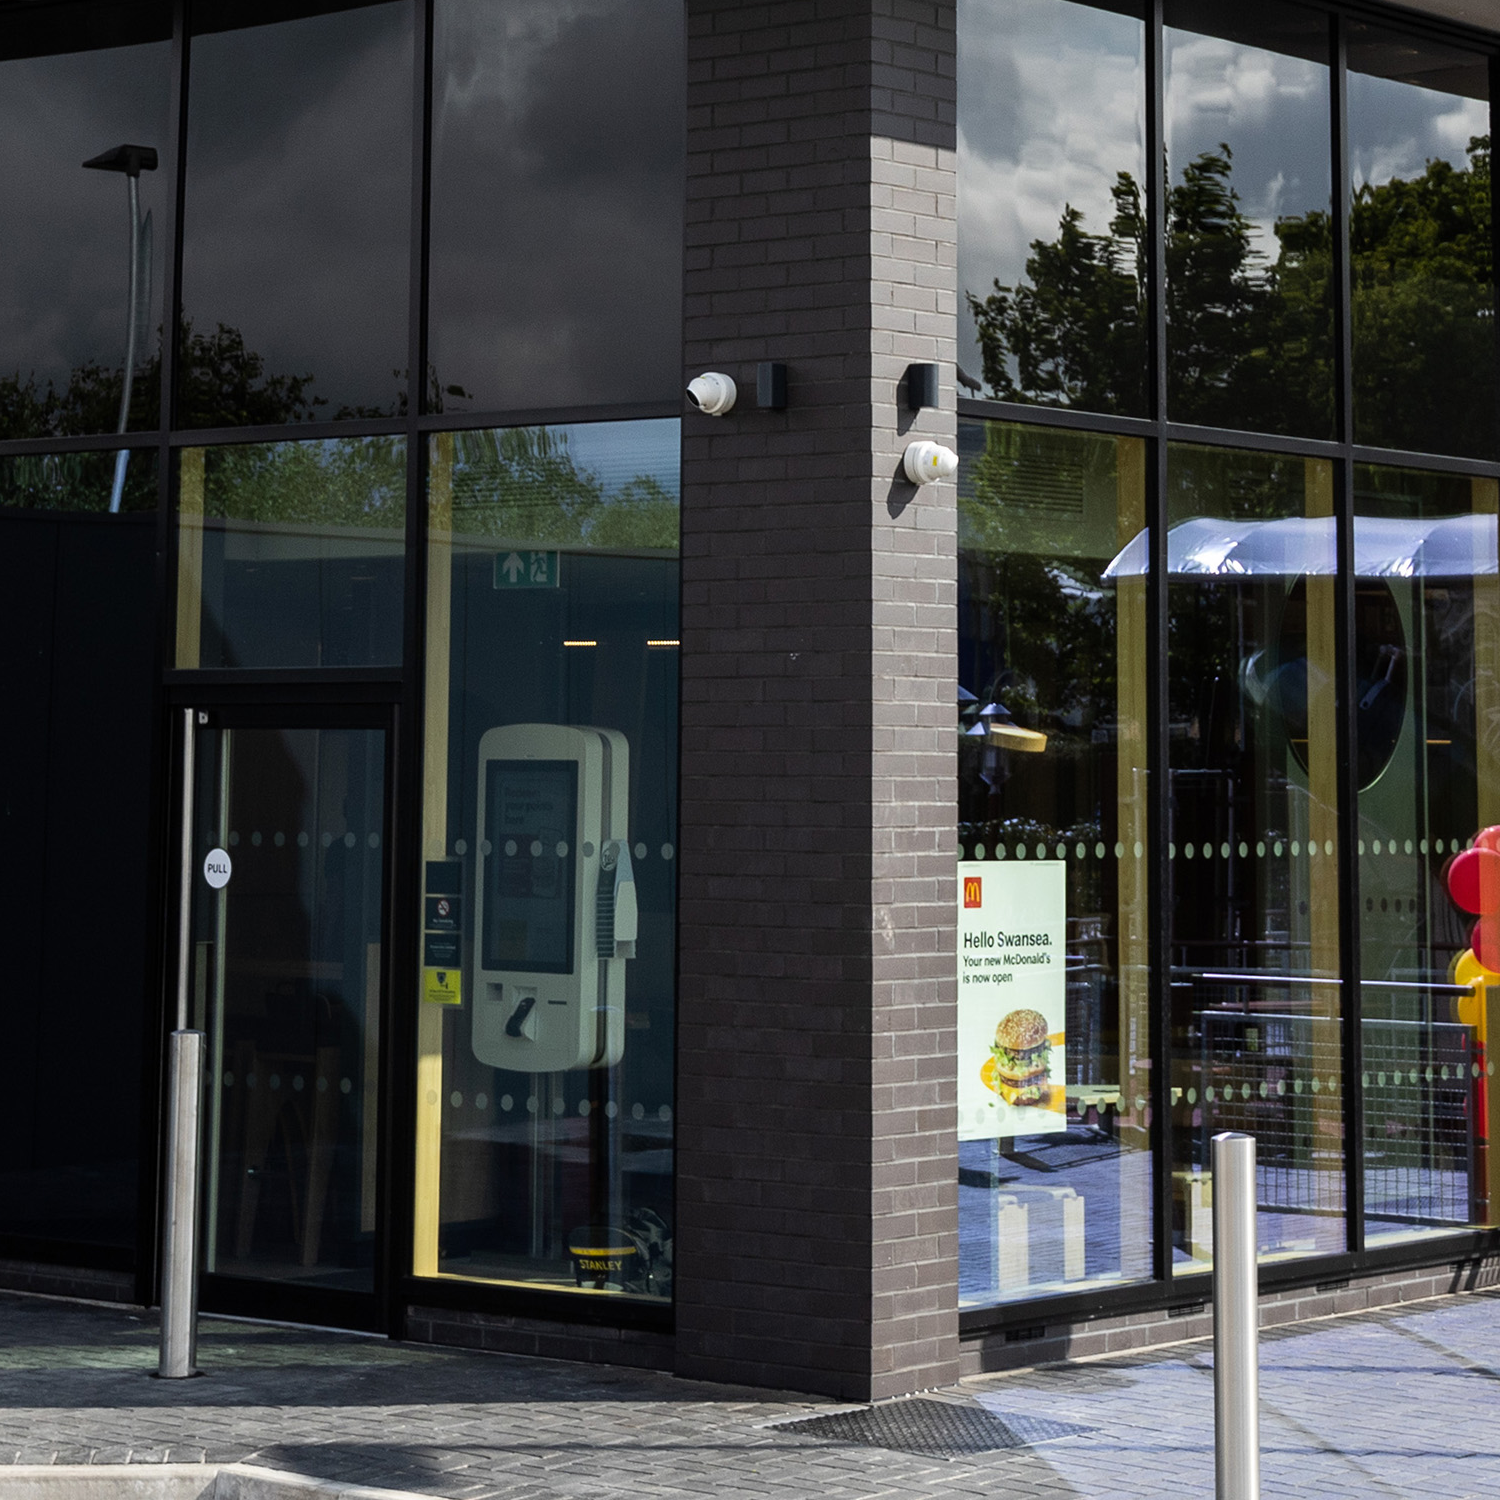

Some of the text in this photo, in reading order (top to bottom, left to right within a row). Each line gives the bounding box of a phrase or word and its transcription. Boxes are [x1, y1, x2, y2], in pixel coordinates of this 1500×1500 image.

[207, 863, 228, 874] PULL
[964, 931, 1052, 948] Hello Swansea.
[963, 953, 1052, 967] Your new McDonald's
[963, 971, 1013, 985] is now open
[579, 1259, 622, 1271] STANLEY
